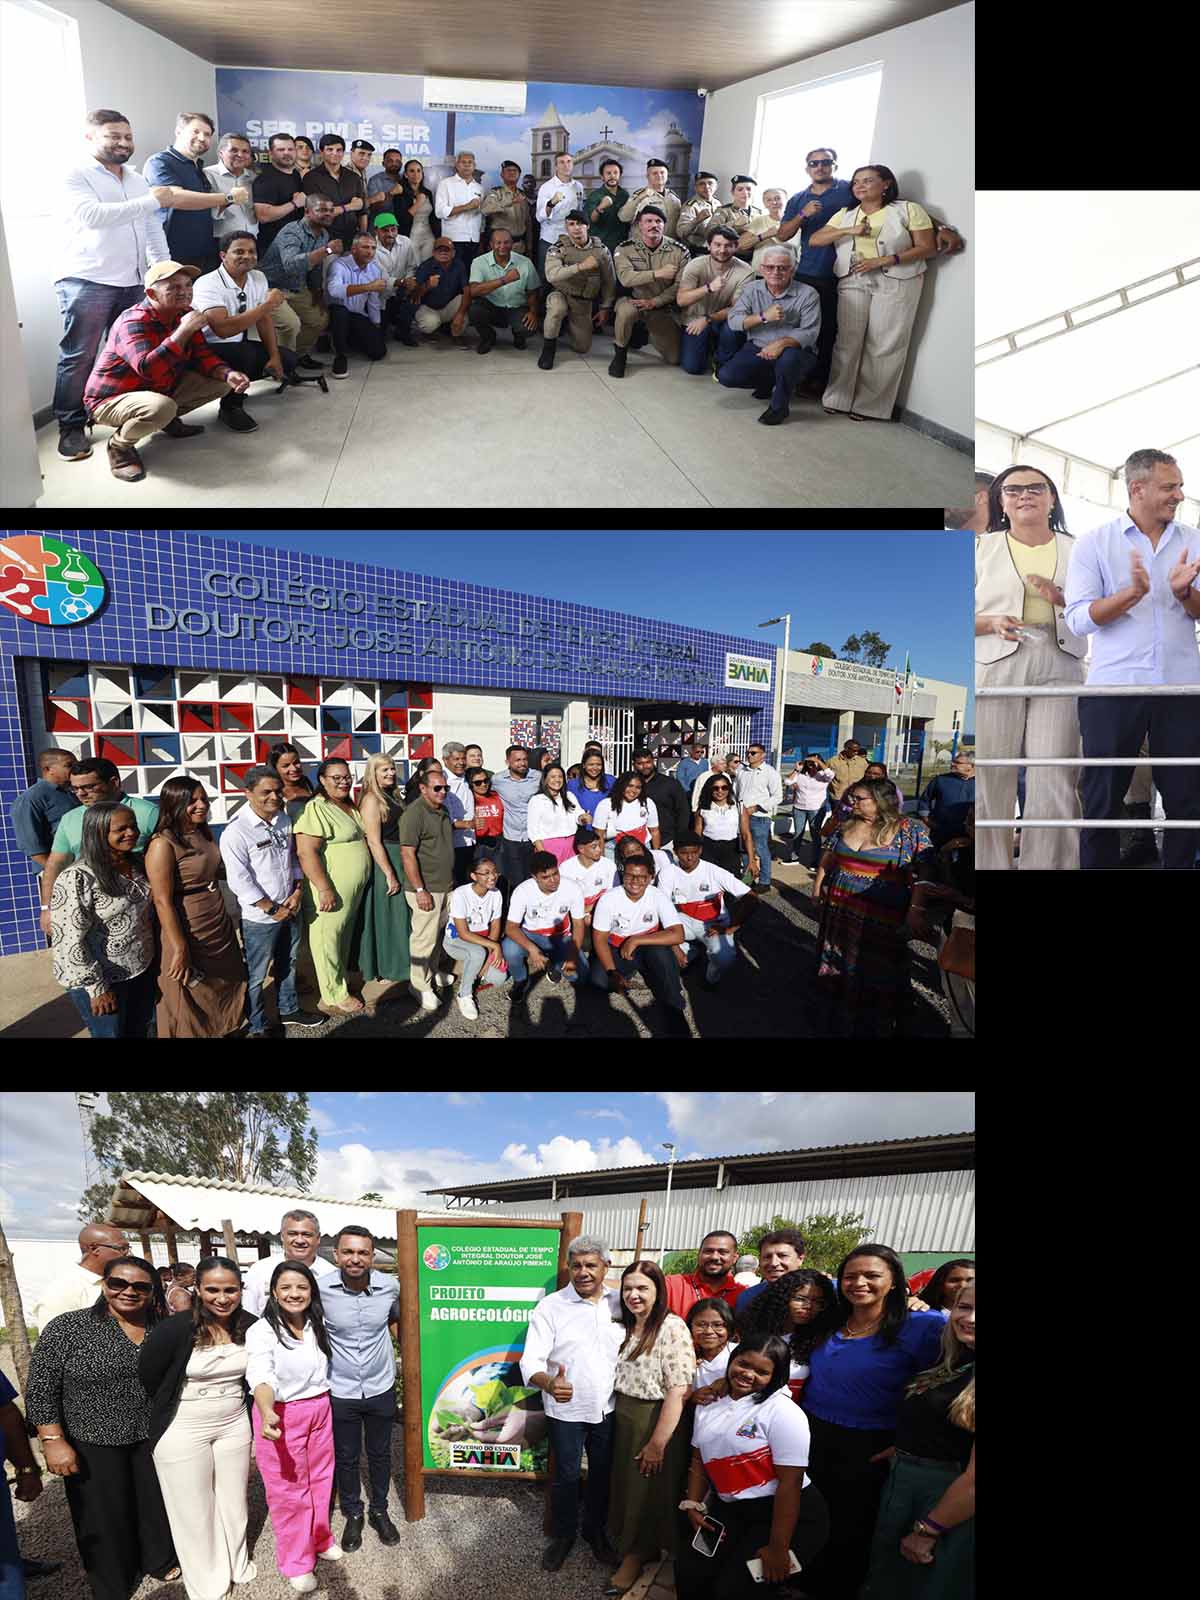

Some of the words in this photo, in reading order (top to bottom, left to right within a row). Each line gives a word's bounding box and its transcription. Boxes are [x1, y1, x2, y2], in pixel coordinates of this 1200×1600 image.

[246, 119, 297, 136] SER
[305, 121, 348, 138] PM
[358, 119, 373, 138] É
[381, 125, 431, 141] SER
[405, 144, 431, 155] NA
[203, 569, 366, 615] COLÉGIO
[375, 595, 515, 635] ESTADUAL
[520, 616, 550, 640] DE
[145, 602, 316, 646] DOUTOR
[331, 625, 412, 654] JOSÉ
[420, 637, 535, 667] ANTÔNIO
[543, 651, 569, 672] DE
[728, 663, 769, 683] BAHIA
[431, 1287, 485, 1300] PROJETO
[430, 1306, 535, 1322] AGROECOLÓGIC
[453, 1450, 517, 1466] BAHIA
